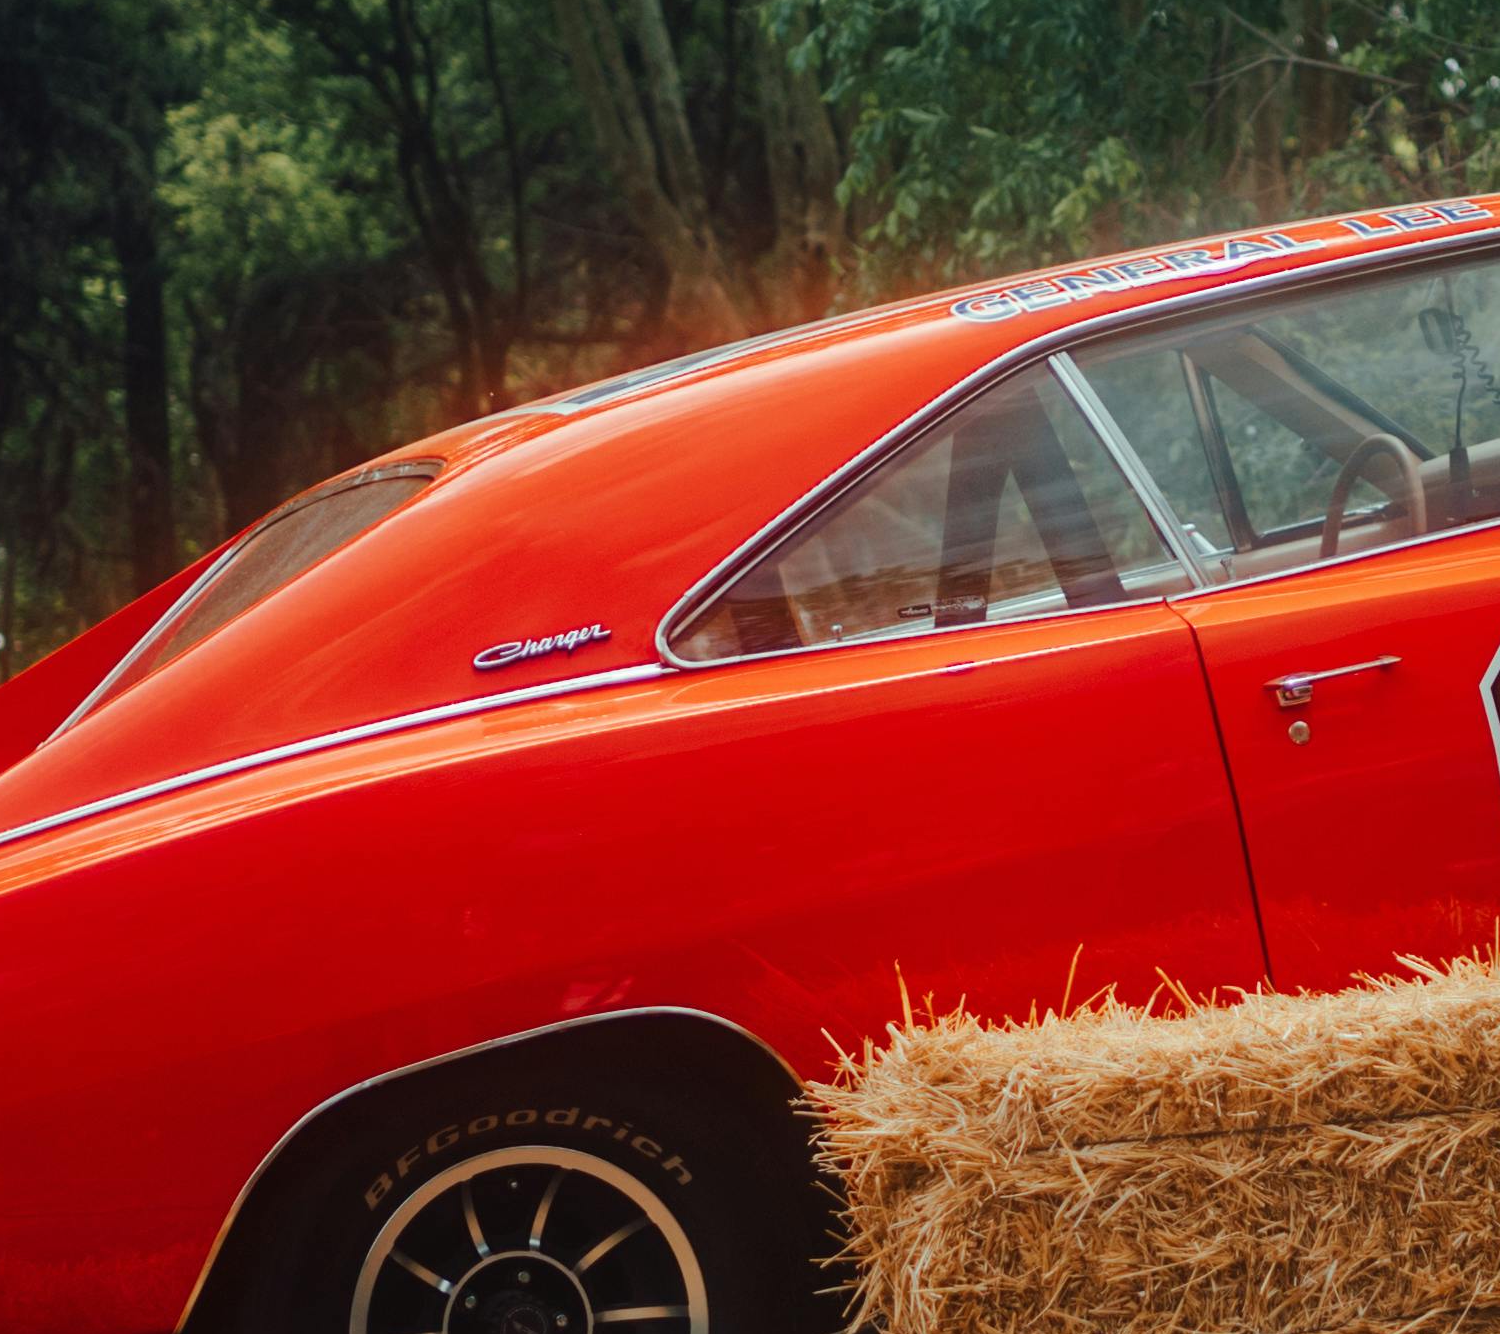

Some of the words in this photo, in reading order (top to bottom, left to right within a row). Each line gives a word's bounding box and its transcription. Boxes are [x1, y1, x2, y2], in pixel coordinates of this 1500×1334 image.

[950, 232, 1326, 323] GENERAL
[1337, 200, 1494, 240] LEE
[473, 623, 611, 668] Charger
[363, 1107, 693, 1211] BFGoodrich
